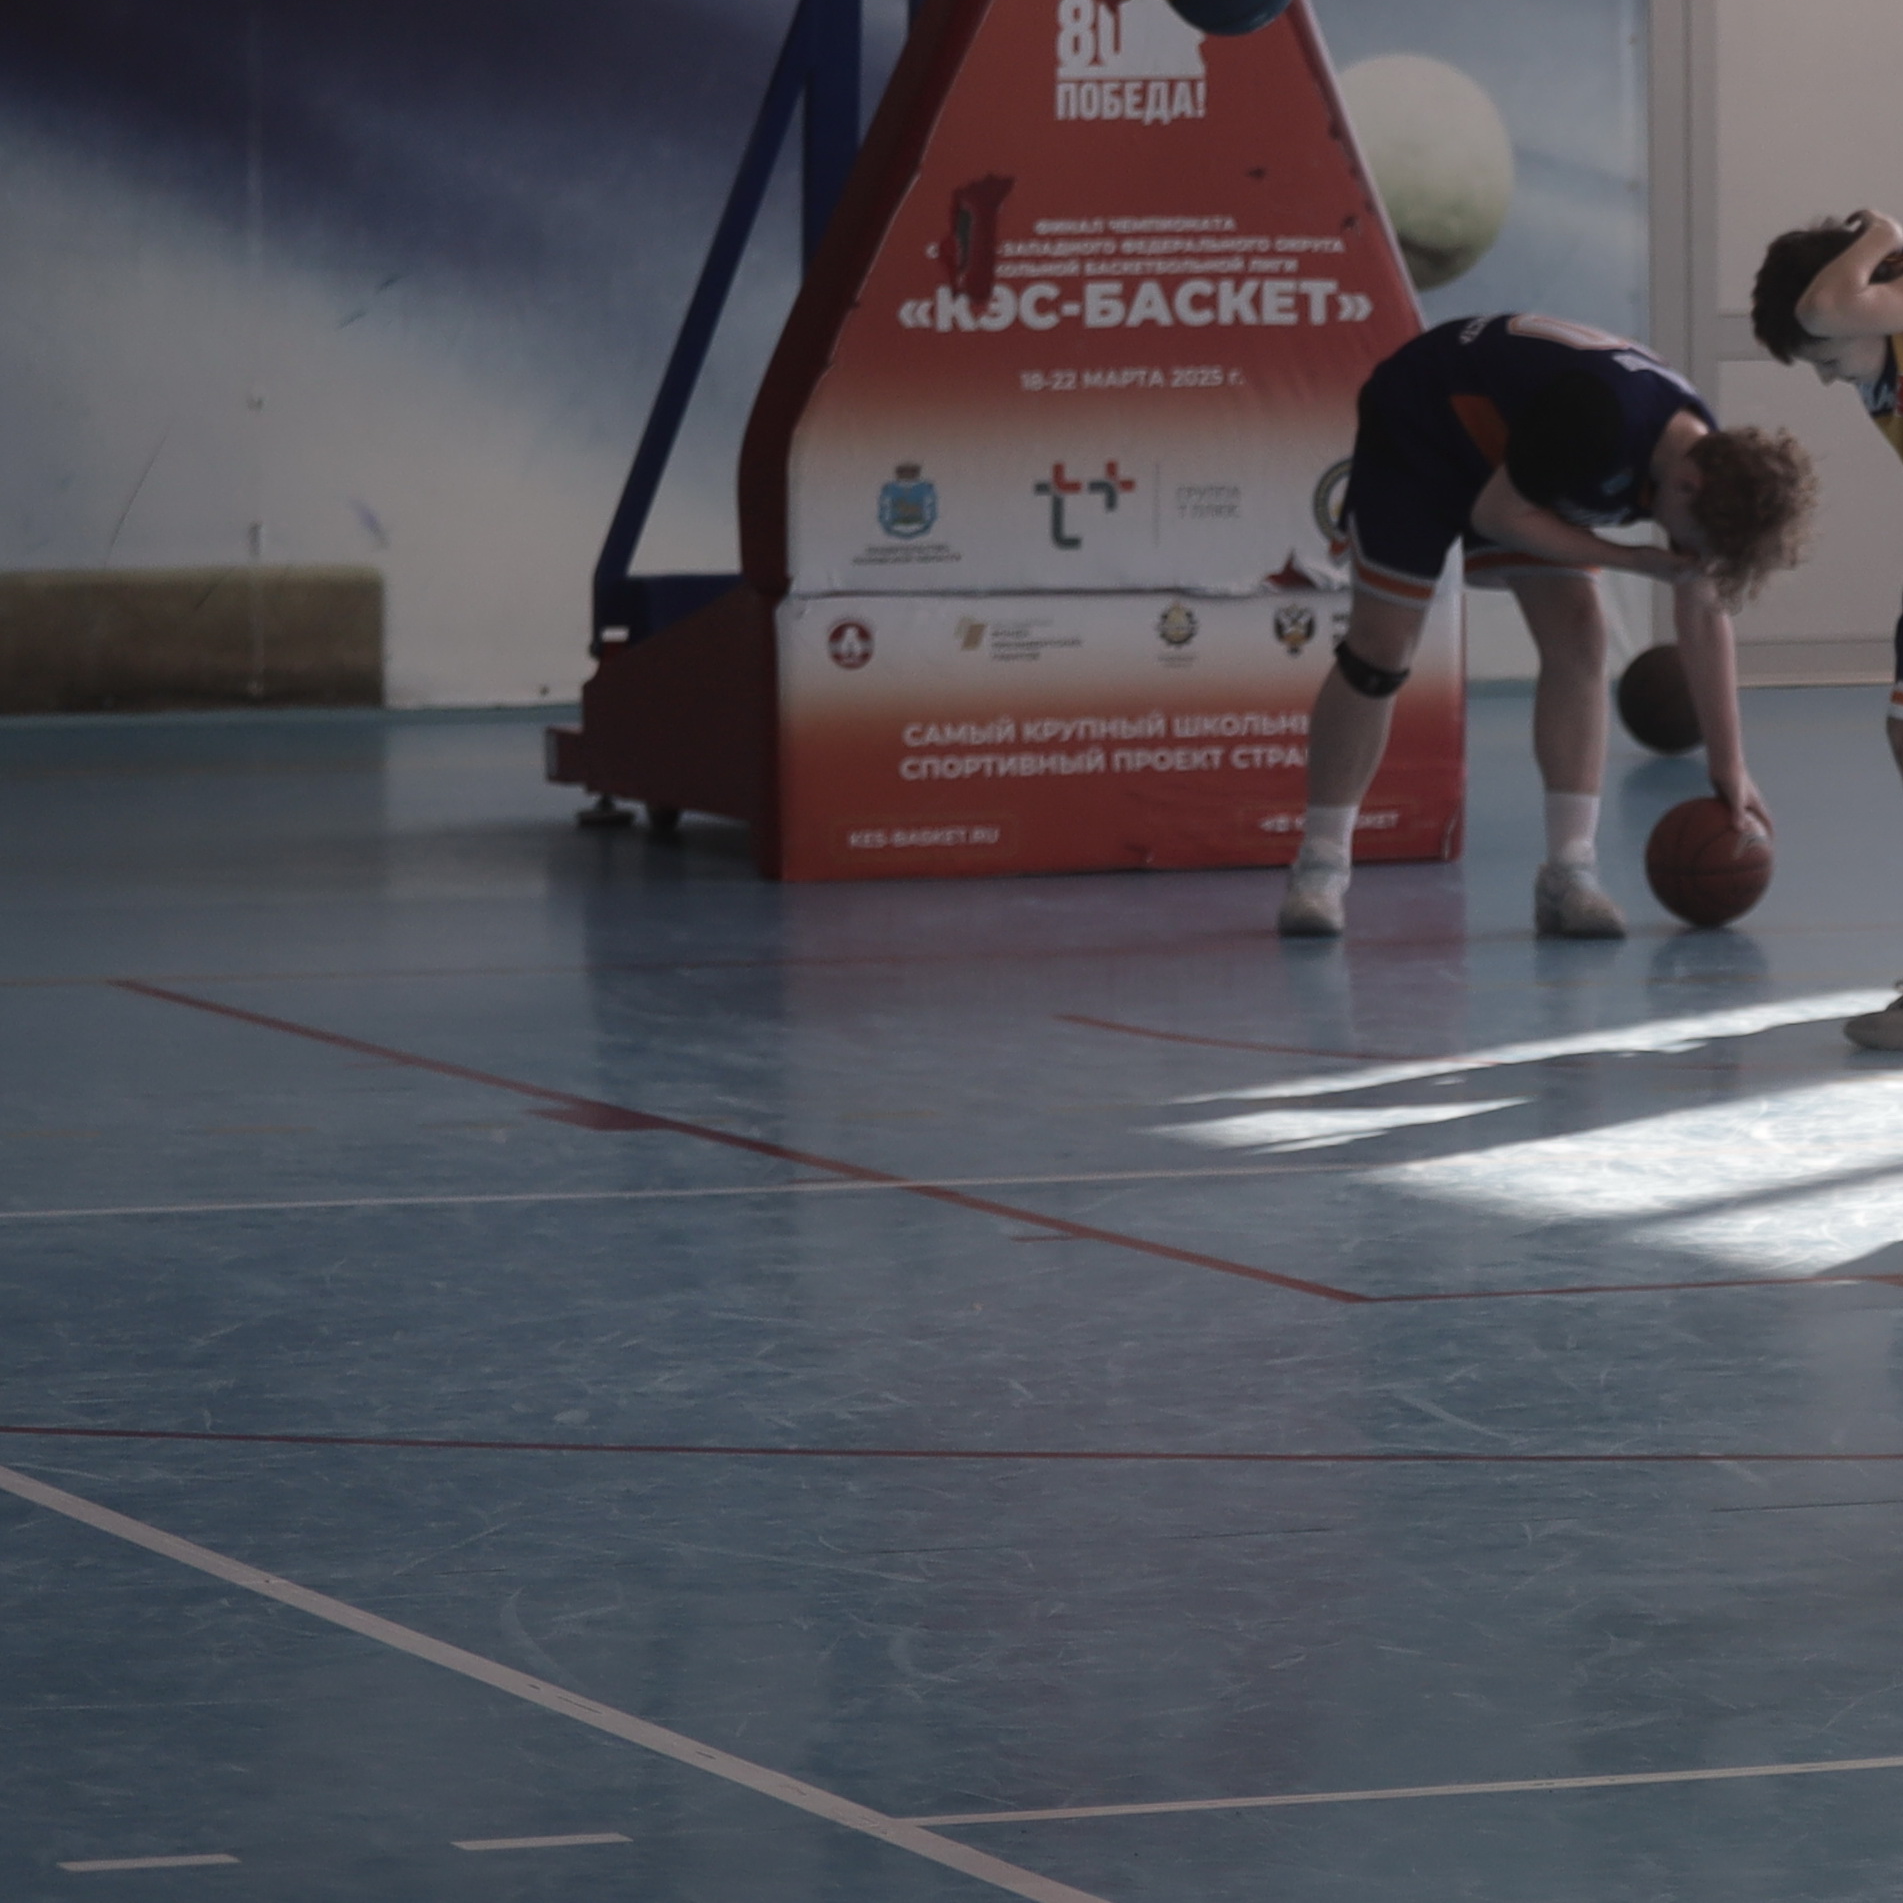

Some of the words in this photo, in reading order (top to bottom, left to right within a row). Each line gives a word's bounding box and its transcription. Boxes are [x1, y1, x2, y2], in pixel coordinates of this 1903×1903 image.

[1055, 81, 1207, 125] ПОБЕДА!
[898, 279, 1374, 333] «КЭС-БАСКЕТ»
[1082, 367, 1165, 389] МАРТА
[904, 713, 1016, 748] САМЫЙ
[1020, 708, 1164, 743] КРУПНЫЙ
[1171, 711, 1309, 739] ШКОЛЬН
[900, 744, 1105, 782] СПОРТИВНЫЙ
[1111, 747, 1226, 774] ПРОЕКТ
[1230, 744, 1309, 769] СТРА
